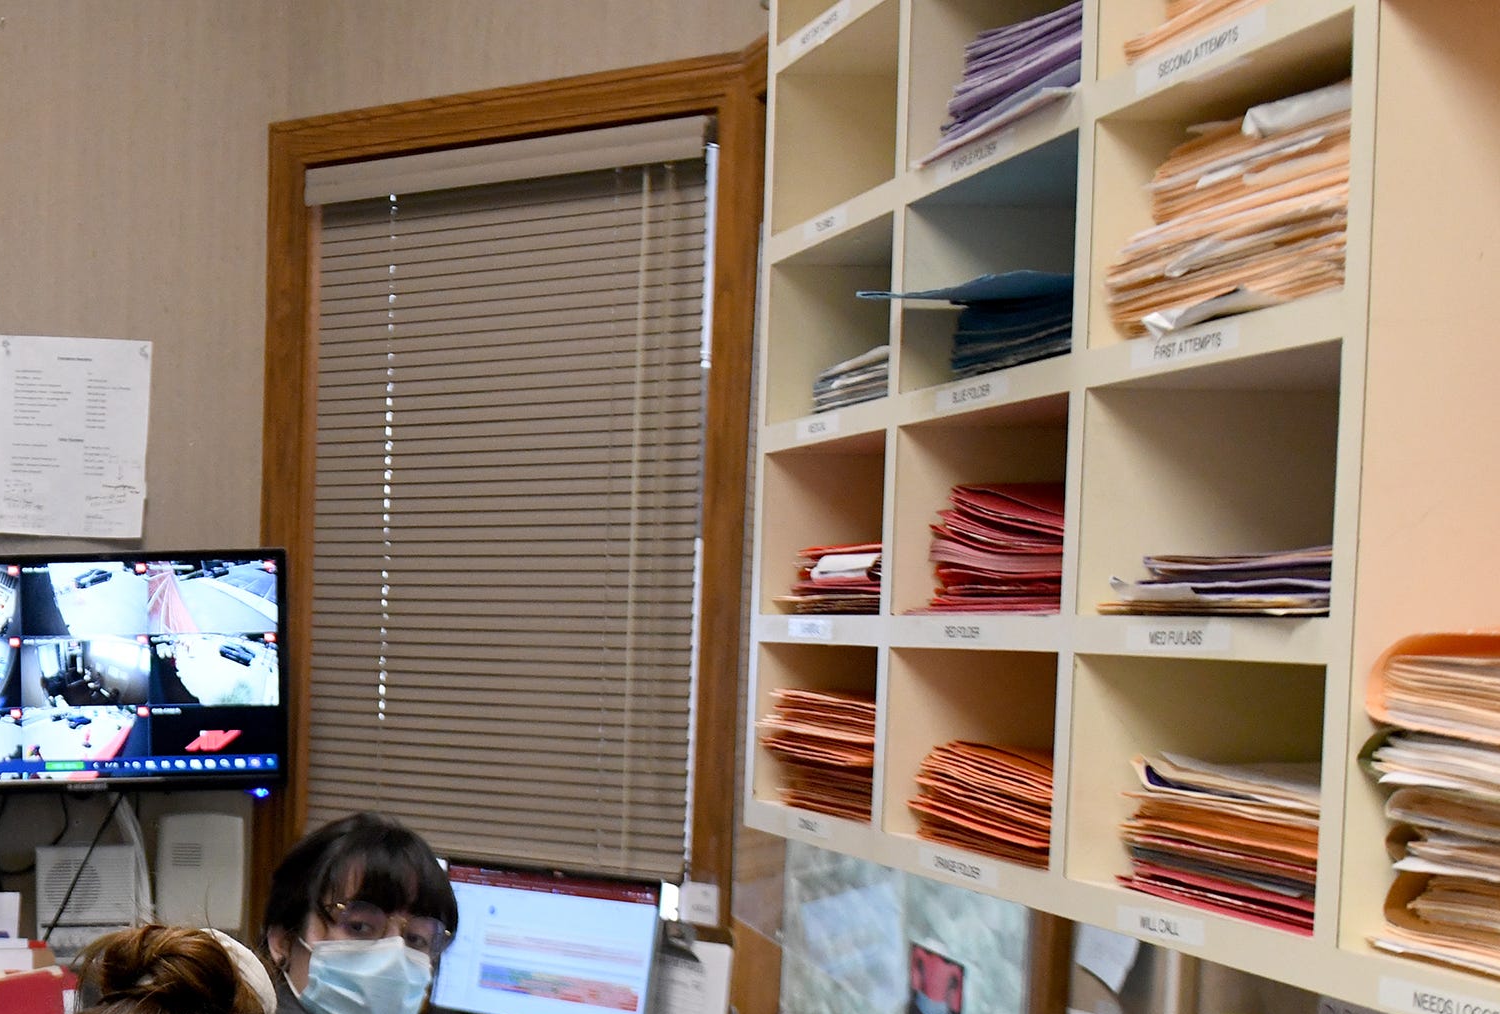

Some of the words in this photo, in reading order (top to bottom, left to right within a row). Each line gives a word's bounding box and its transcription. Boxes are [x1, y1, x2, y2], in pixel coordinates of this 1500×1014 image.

[1157, 48, 1192, 78] SECOND
[1194, 25, 1240, 61] ATTEMPTS
[1153, 342, 1176, 360] FIRST
[1177, 331, 1223, 356] ATTEMPTS
